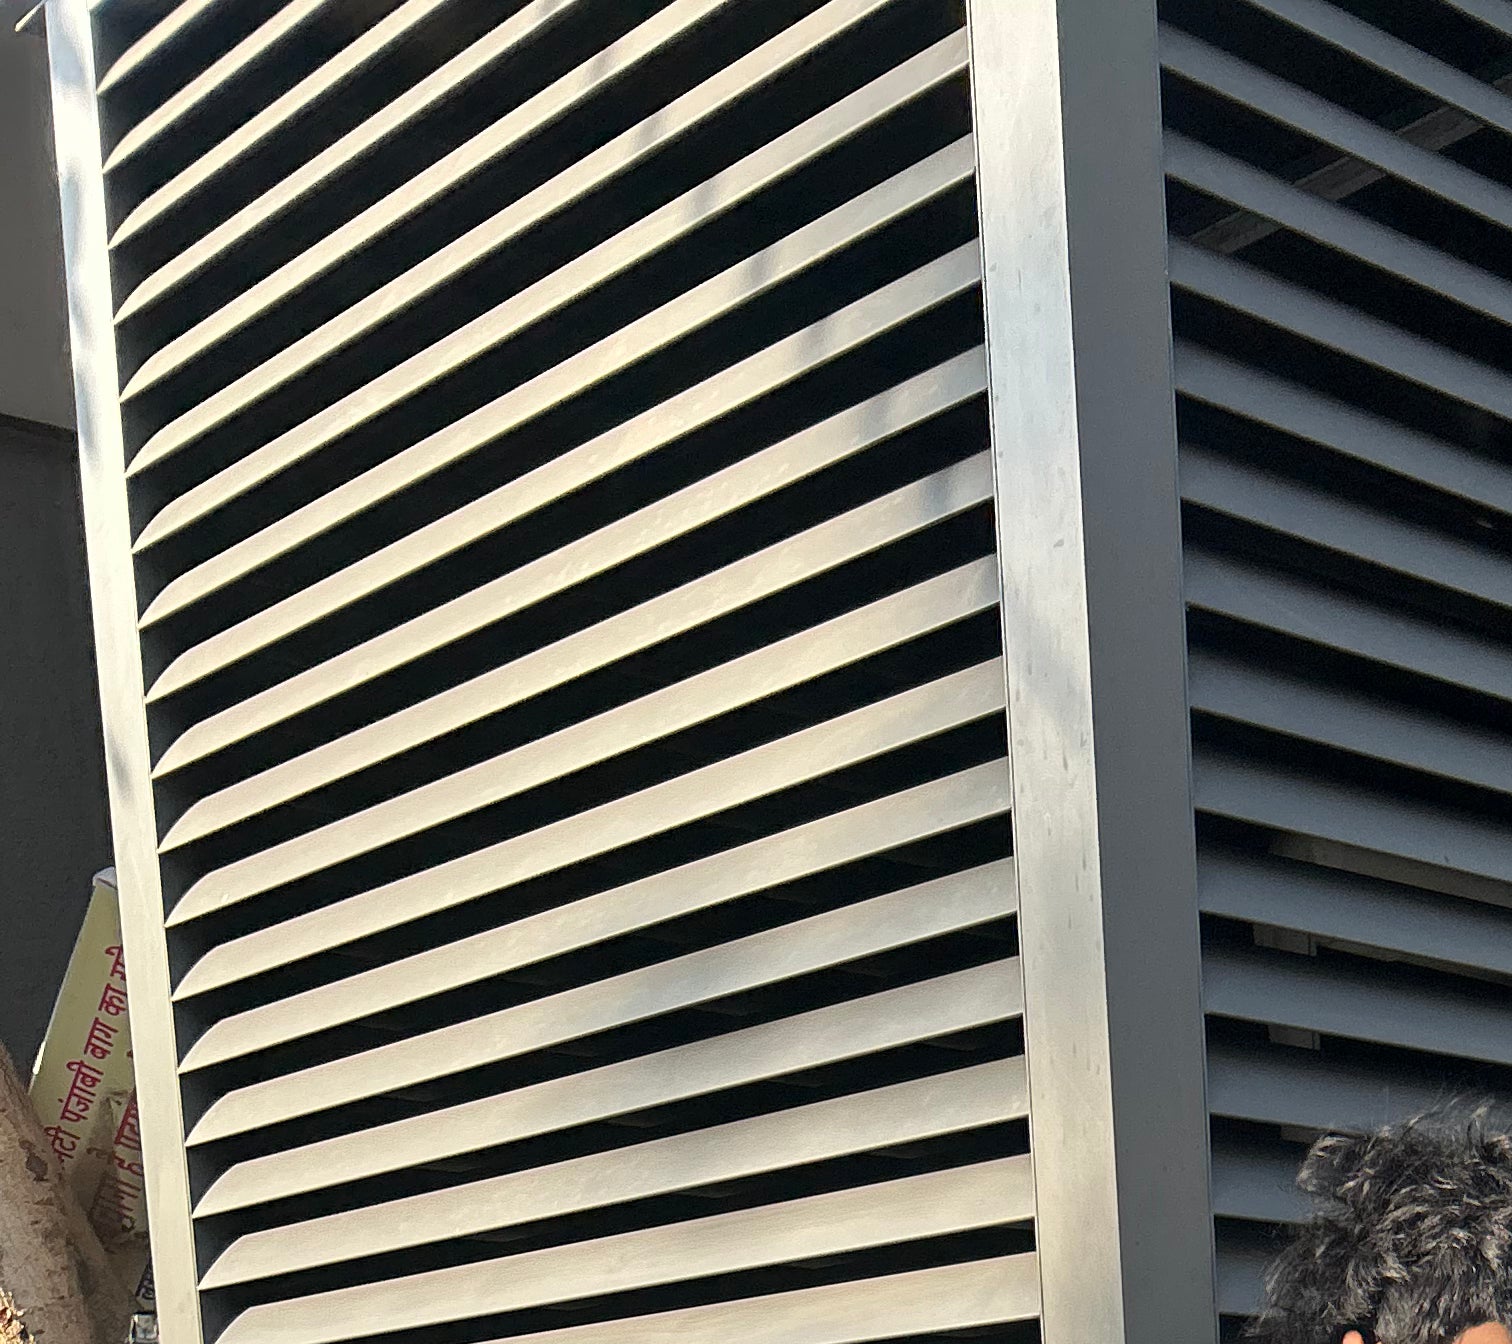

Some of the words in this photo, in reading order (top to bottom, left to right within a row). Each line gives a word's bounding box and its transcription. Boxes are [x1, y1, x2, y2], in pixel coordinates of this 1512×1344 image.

[98, 983, 127, 1016] का
[84, 1017, 118, 1060] बाग
[58, 1059, 104, 1123] पंजाबी
